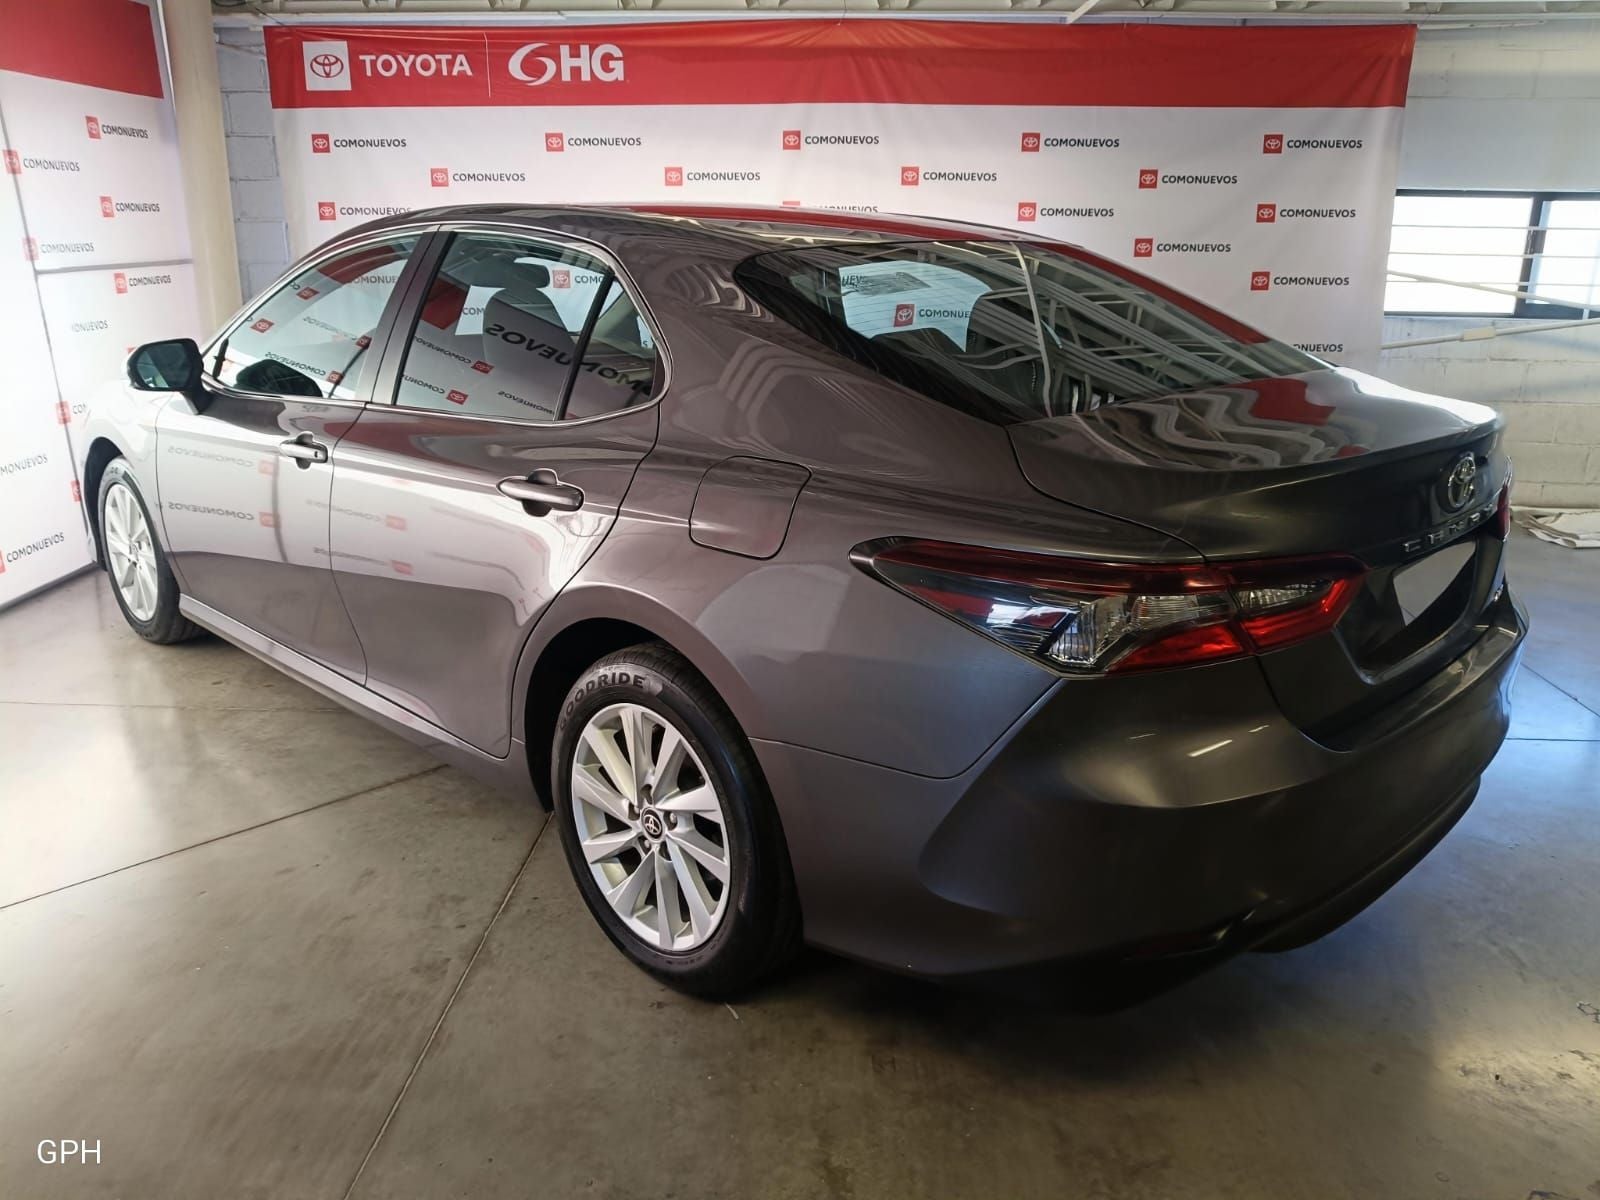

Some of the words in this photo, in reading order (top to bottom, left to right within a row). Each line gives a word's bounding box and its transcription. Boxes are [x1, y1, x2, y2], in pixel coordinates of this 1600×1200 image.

[359, 53, 473, 77] TOYOTA
[102, 124, 149, 139] COMONUEVOS
[333, 138, 407, 148] COMONUEVOS
[567, 136, 642, 147] COMONUEVOS
[804, 135, 880, 145] COMONUEVOS
[1043, 137, 1120, 148] COMONUEVOS
[1286, 138, 1363, 149] COMONUEVOS
[23, 158, 80, 172] COMONUEVOS
[452, 172, 526, 182] COMONUEVOS
[686, 171, 761, 181] COMONUEVOS
[922, 171, 998, 182] COMONUEVOS
[1161, 174, 1238, 185] COMONUEVOS
[116, 202, 160, 212] COMONUEVOS
[1039, 207, 1115, 217] COMONUEVOS
[1279, 208, 1356, 218] COMONUEVOS
[41, 242, 94, 254] COMONUEVOS
[1156, 243, 1232, 253] COMONUEVOS
[129, 274, 171, 287] COMONUEVOS
[1273, 276, 1350, 287] COMONUEVOS
[6, 531, 65, 563] COMONUEVOS
